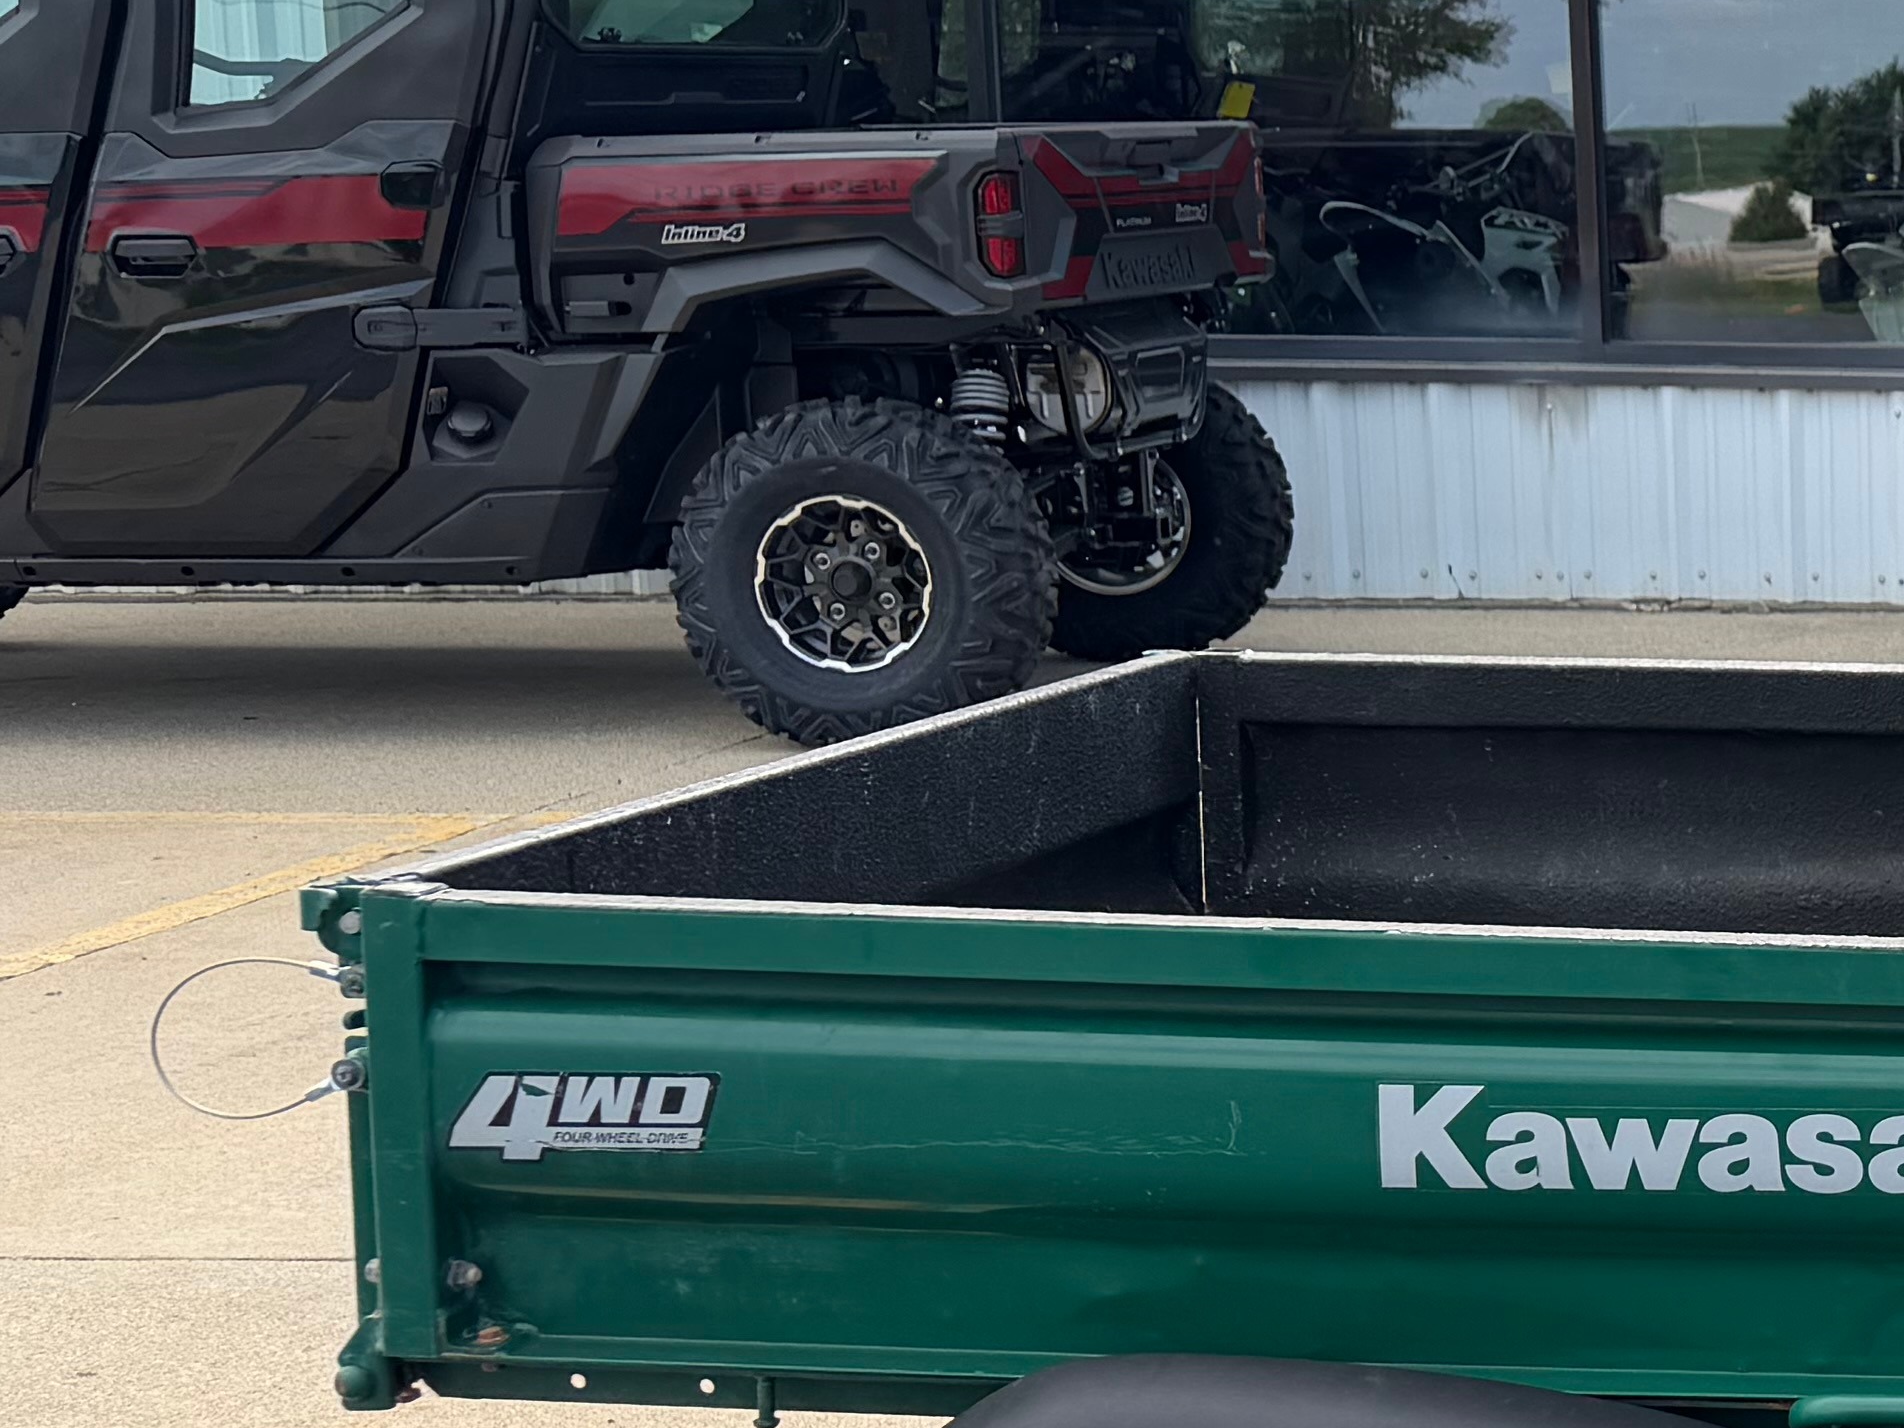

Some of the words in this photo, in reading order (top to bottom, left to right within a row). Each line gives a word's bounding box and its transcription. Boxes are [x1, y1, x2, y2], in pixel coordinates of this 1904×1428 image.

[791, 179, 899, 195] CREW
[1101, 243, 1196, 290] Kawasaki
[449, 1074, 713, 1160] 4WD
